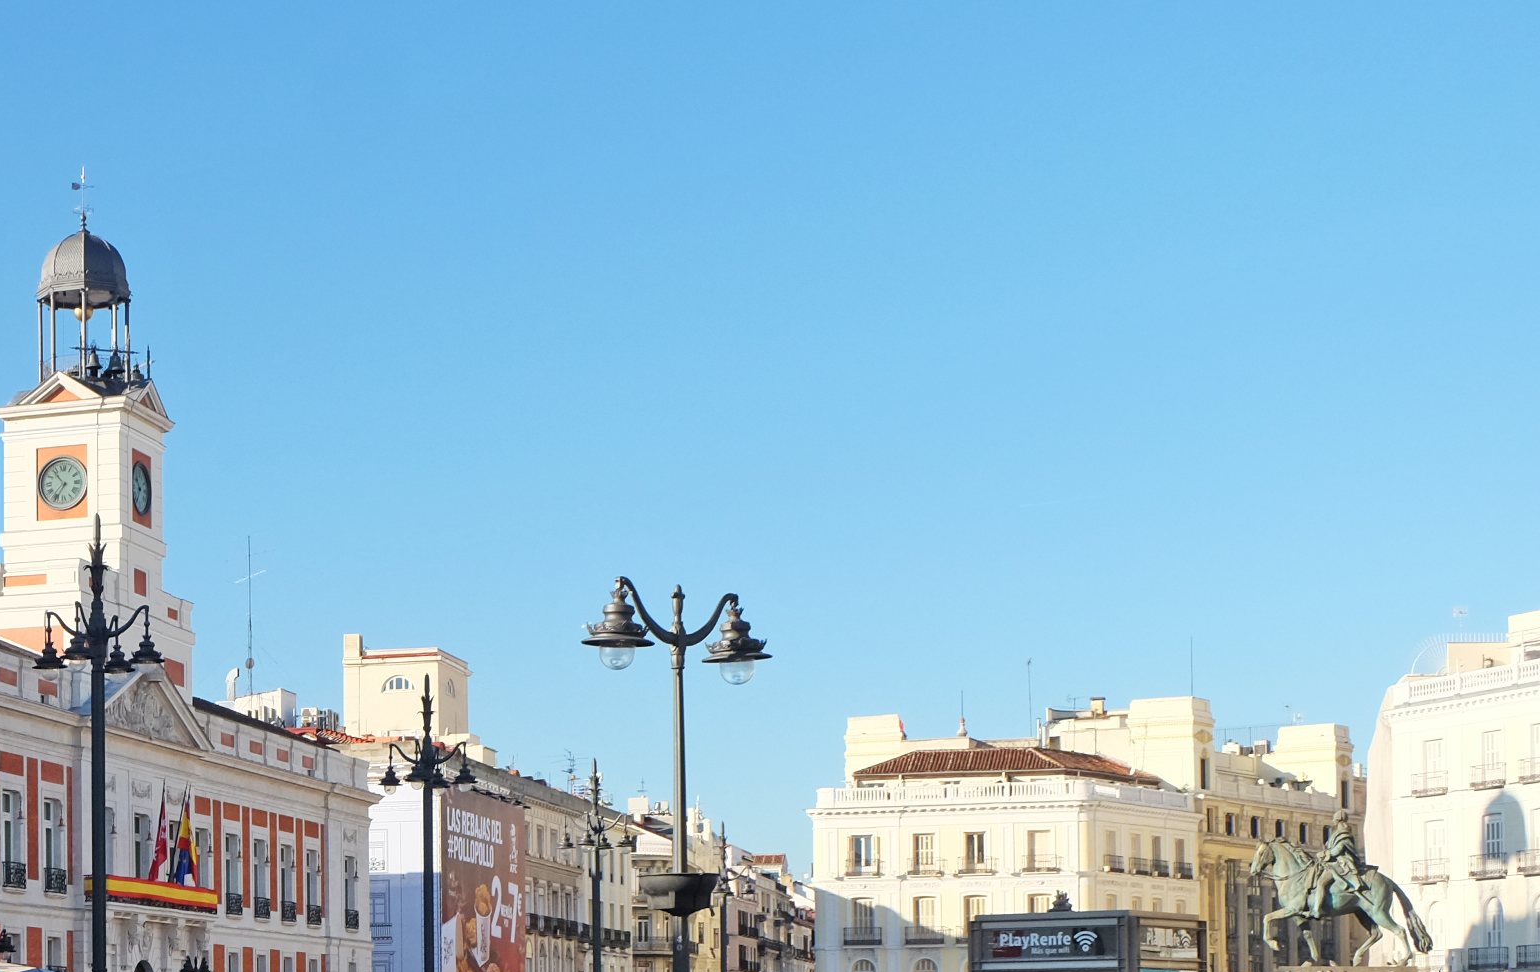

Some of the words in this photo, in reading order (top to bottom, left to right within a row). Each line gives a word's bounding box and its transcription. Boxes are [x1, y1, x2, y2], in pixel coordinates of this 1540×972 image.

[446, 806, 461, 834] LAS
[461, 810, 491, 842] REBAJAS
[491, 819, 503, 845] DEL
[447, 834, 494, 868] #POLLOPOLLO
[491, 875, 502, 939] 2
[999, 931, 1071, 950] PlayRenfe
